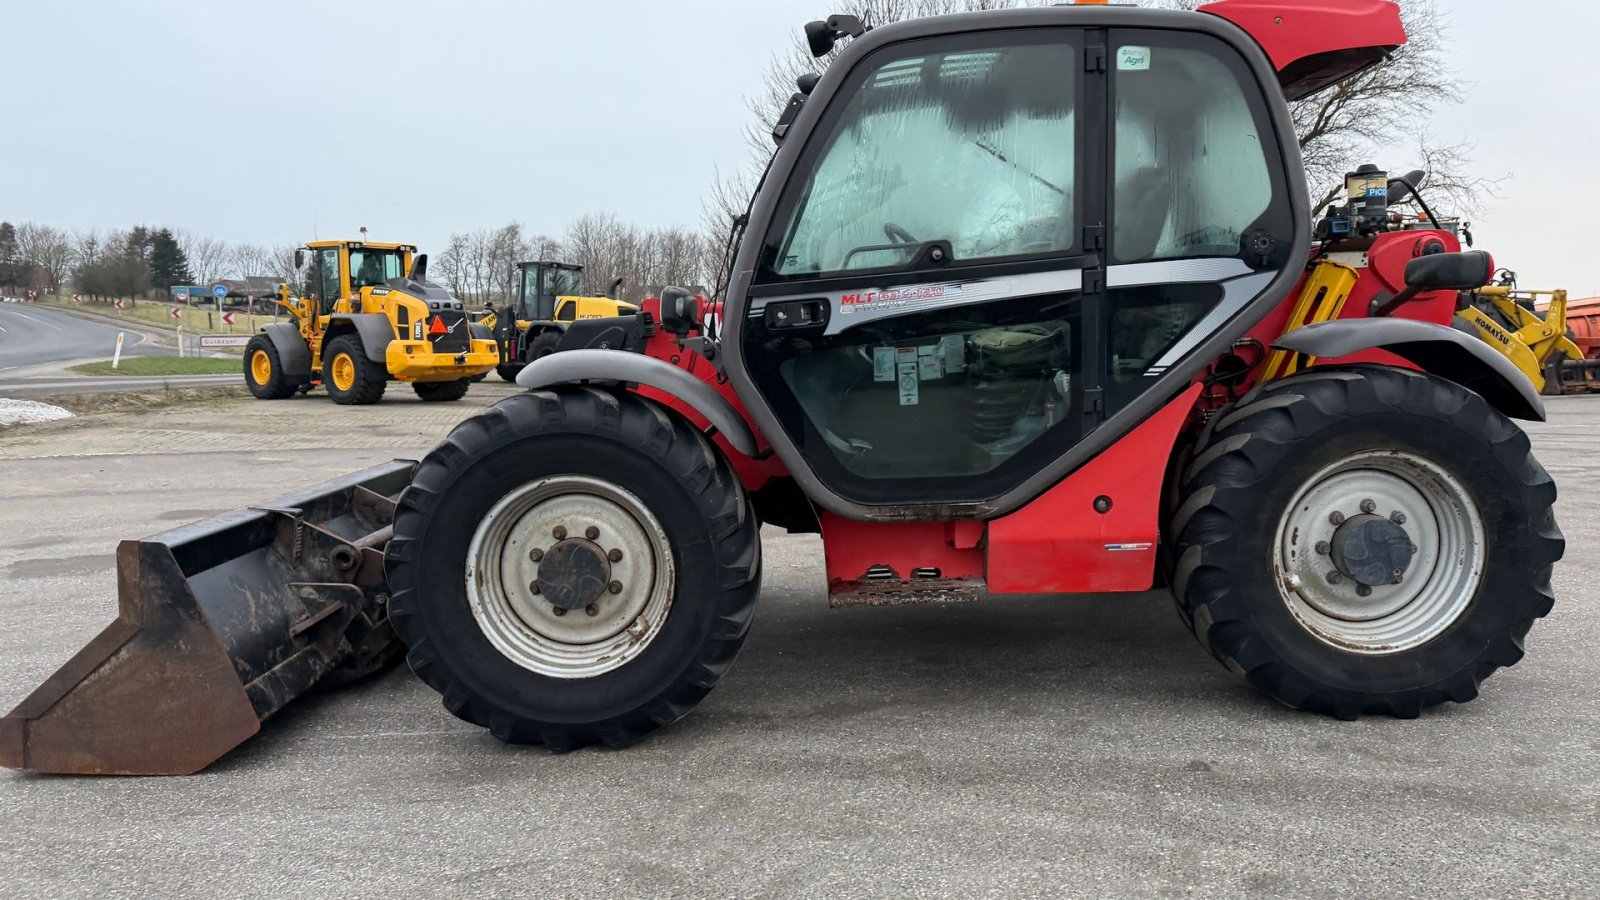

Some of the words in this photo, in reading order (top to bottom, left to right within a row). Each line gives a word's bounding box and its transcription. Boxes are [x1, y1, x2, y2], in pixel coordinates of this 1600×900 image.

[1124, 56, 1145, 65] Agri
[841, 292, 876, 305] MLT
[1475, 316, 1509, 345] KOMATSU
